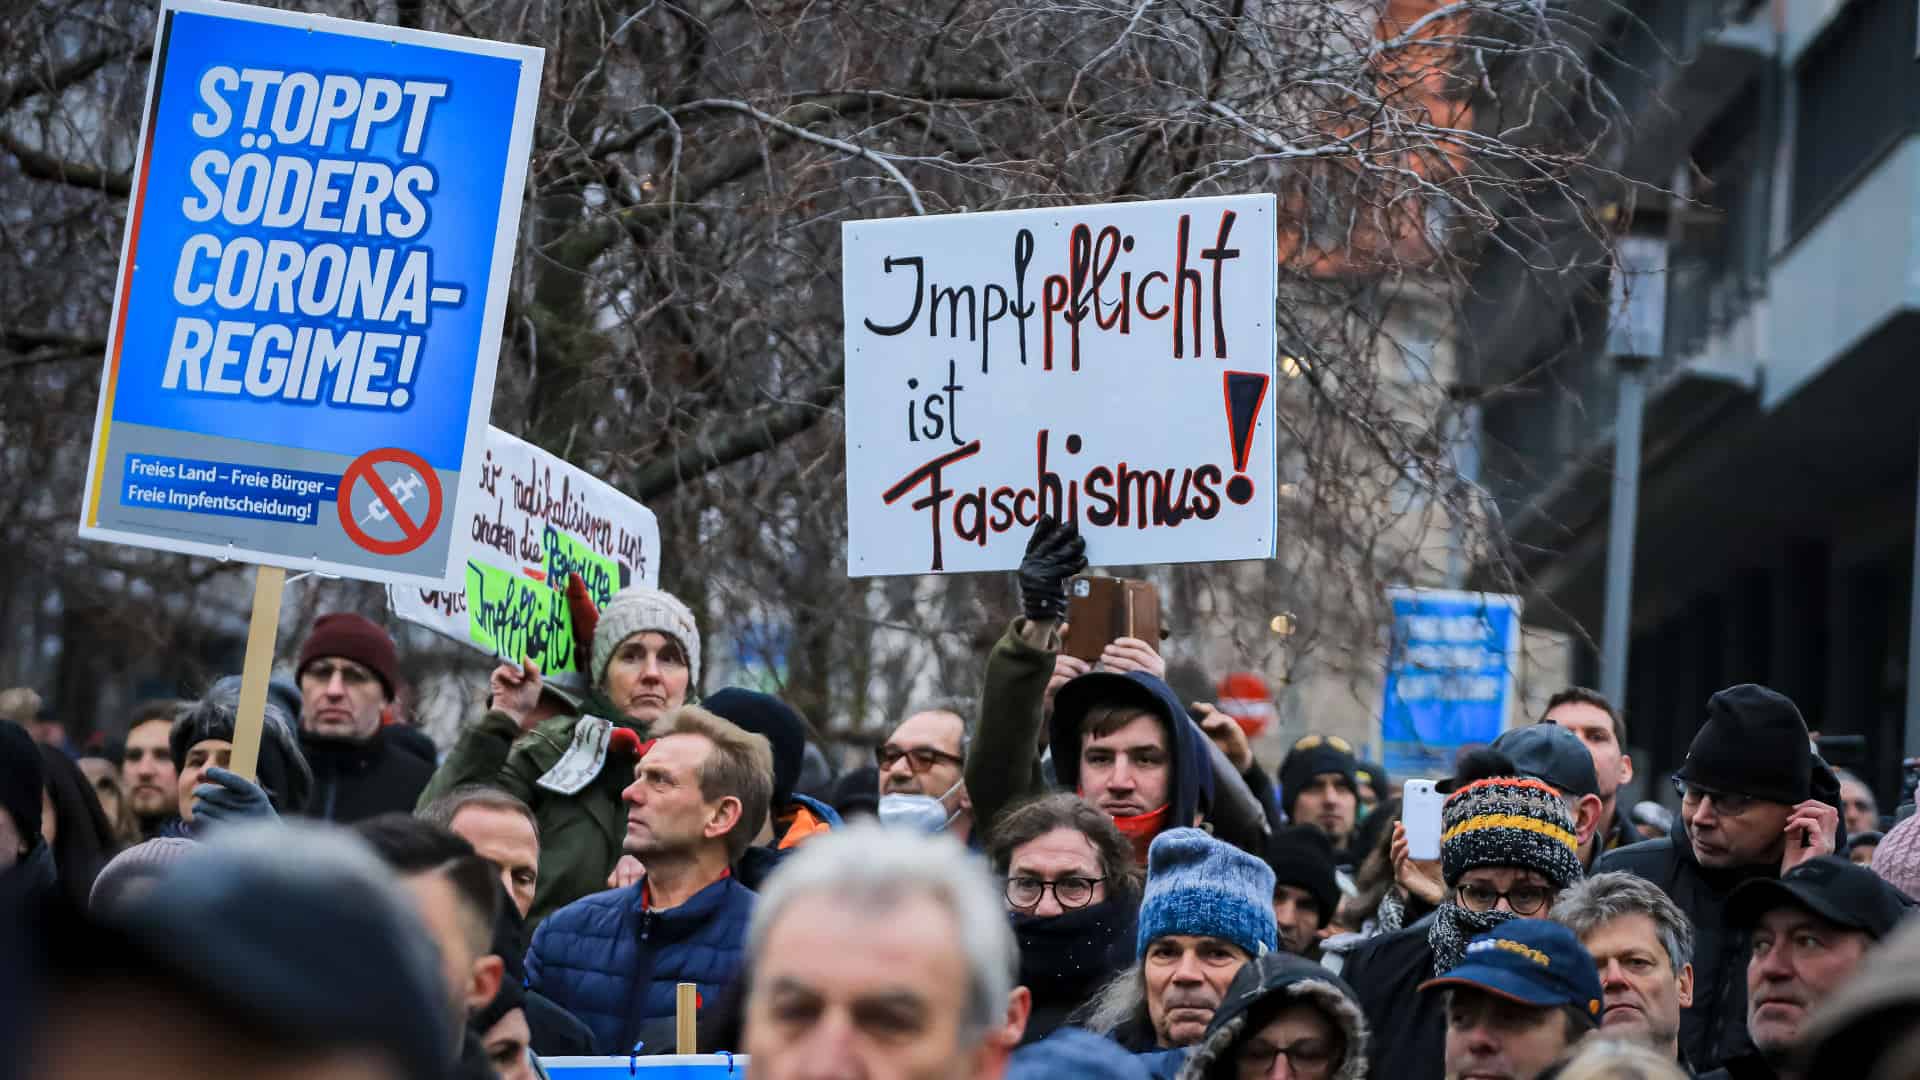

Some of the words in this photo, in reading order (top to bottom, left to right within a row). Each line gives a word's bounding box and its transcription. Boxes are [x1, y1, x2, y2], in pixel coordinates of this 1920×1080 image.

[191, 65, 448, 155] STOPPT
[181, 133, 435, 240] SÖDERS
[173, 234, 463, 325] CORONA-
[863, 209, 1240, 374] Impfpflicht
[161, 316, 422, 408] REGIME!
[908, 359, 966, 447] ist
[127, 485, 167, 503] Freie
[168, 489, 313, 522] Impfentscheidung!
[130, 458, 176, 478] Freies
[178, 464, 217, 483] Land
[231, 469, 269, 489] Freie
[271, 474, 325, 496] Bürger
[479, 449, 503, 497] ir
[882, 370, 1270, 571] Faschismus!
[519, 517, 545, 563] die
